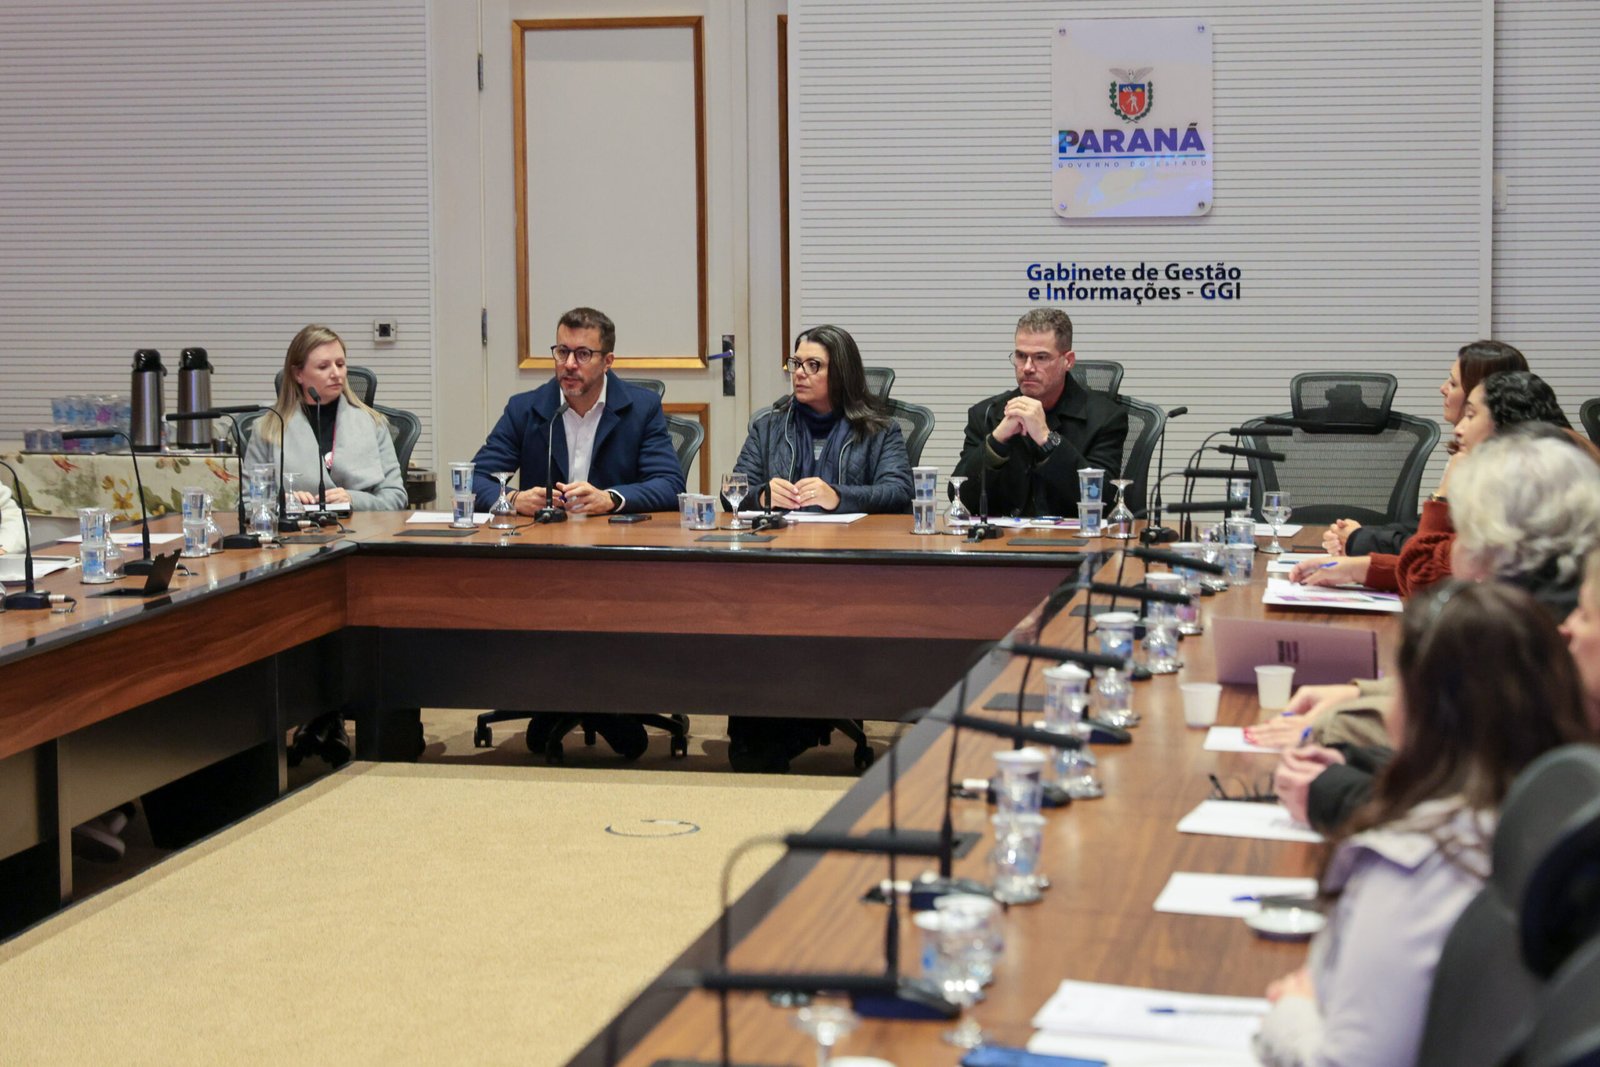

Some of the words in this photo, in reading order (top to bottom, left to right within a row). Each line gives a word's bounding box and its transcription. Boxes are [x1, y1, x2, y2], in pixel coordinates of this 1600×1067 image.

[1058, 122, 1206, 153] PARANÁ
[1027, 262, 1126, 281] Gabinete
[1132, 262, 1159, 281] de
[1165, 262, 1241, 281] Gestão
[1028, 286, 1040, 300] e
[1046, 282, 1181, 305] Informações
[1200, 282, 1241, 300] GGI
